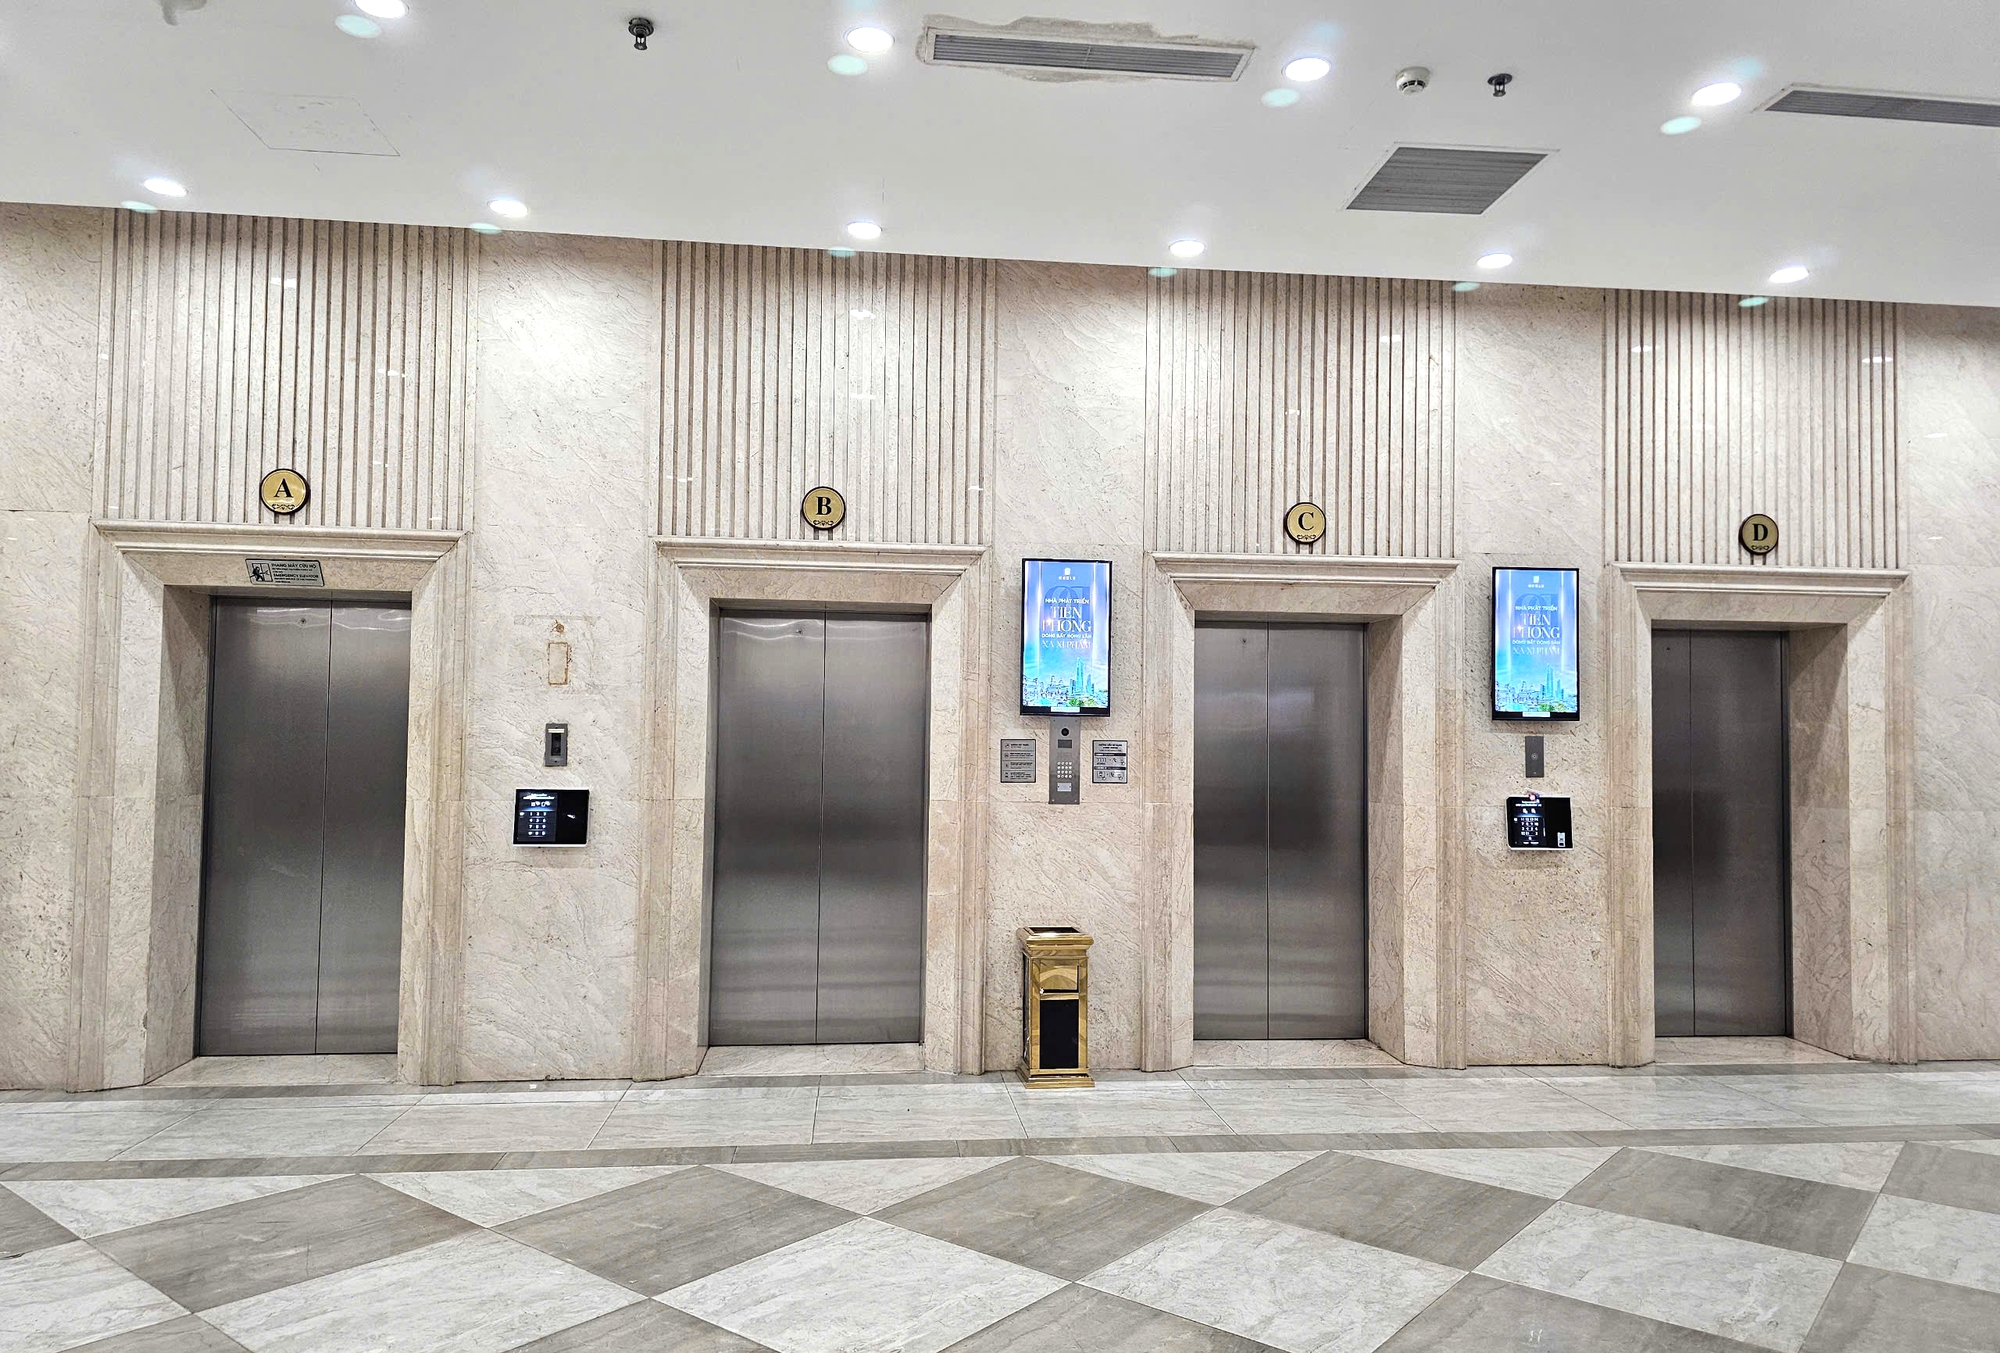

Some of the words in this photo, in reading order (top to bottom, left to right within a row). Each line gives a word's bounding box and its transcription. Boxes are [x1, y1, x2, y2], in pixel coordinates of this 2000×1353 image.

[273, 478, 294, 498] A
[815, 496, 832, 516] B
[1298, 512, 1314, 531] C
[1752, 523, 1769, 542] D
